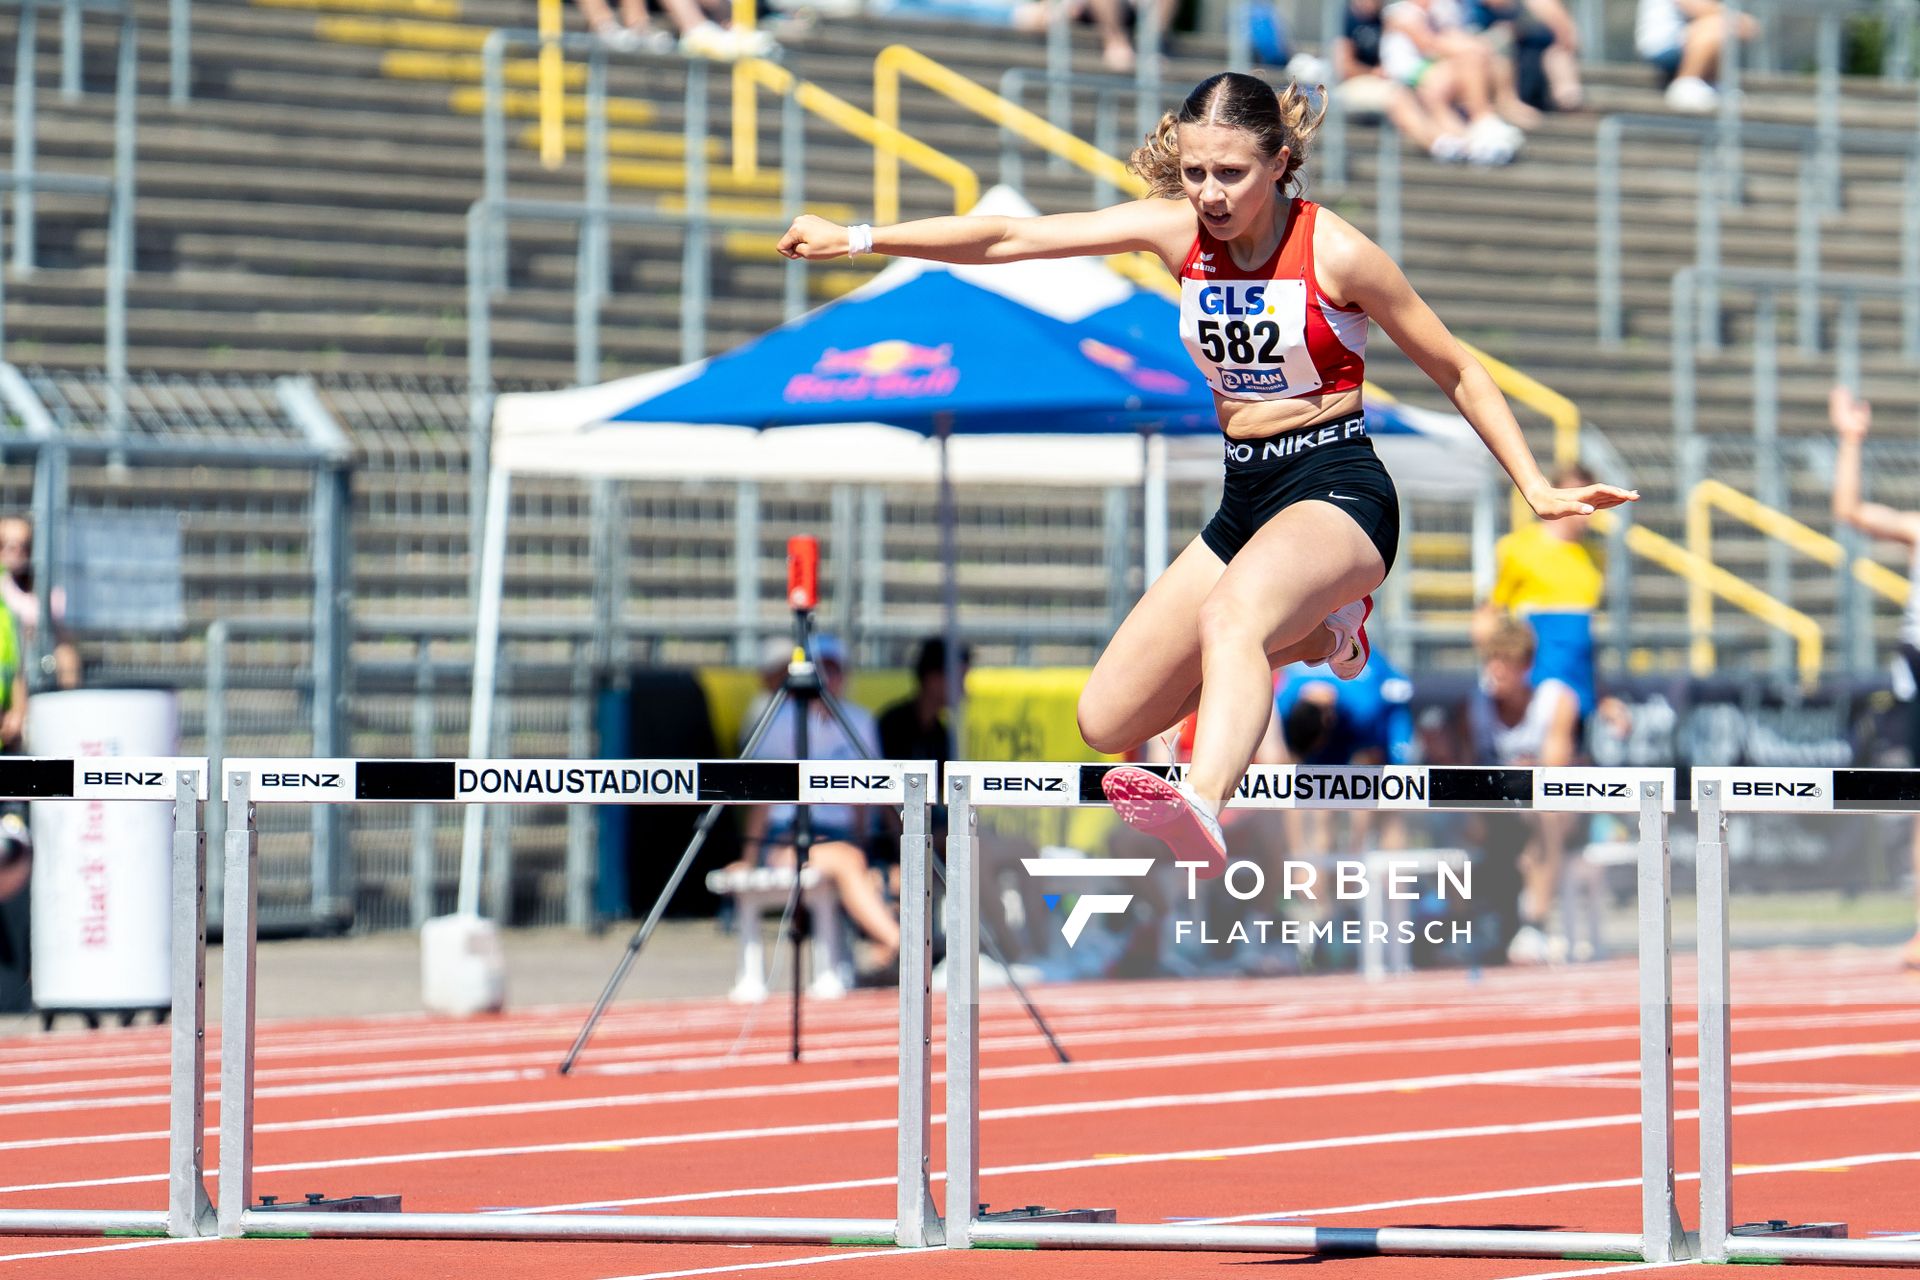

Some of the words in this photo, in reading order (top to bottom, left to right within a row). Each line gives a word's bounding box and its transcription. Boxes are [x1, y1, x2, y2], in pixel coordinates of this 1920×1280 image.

[1198, 320, 1285, 364] 582
[1242, 373, 1282, 385] PLAN
[1262, 424, 1339, 460] NIKE
[459, 768, 694, 795] DONAUSTADION
